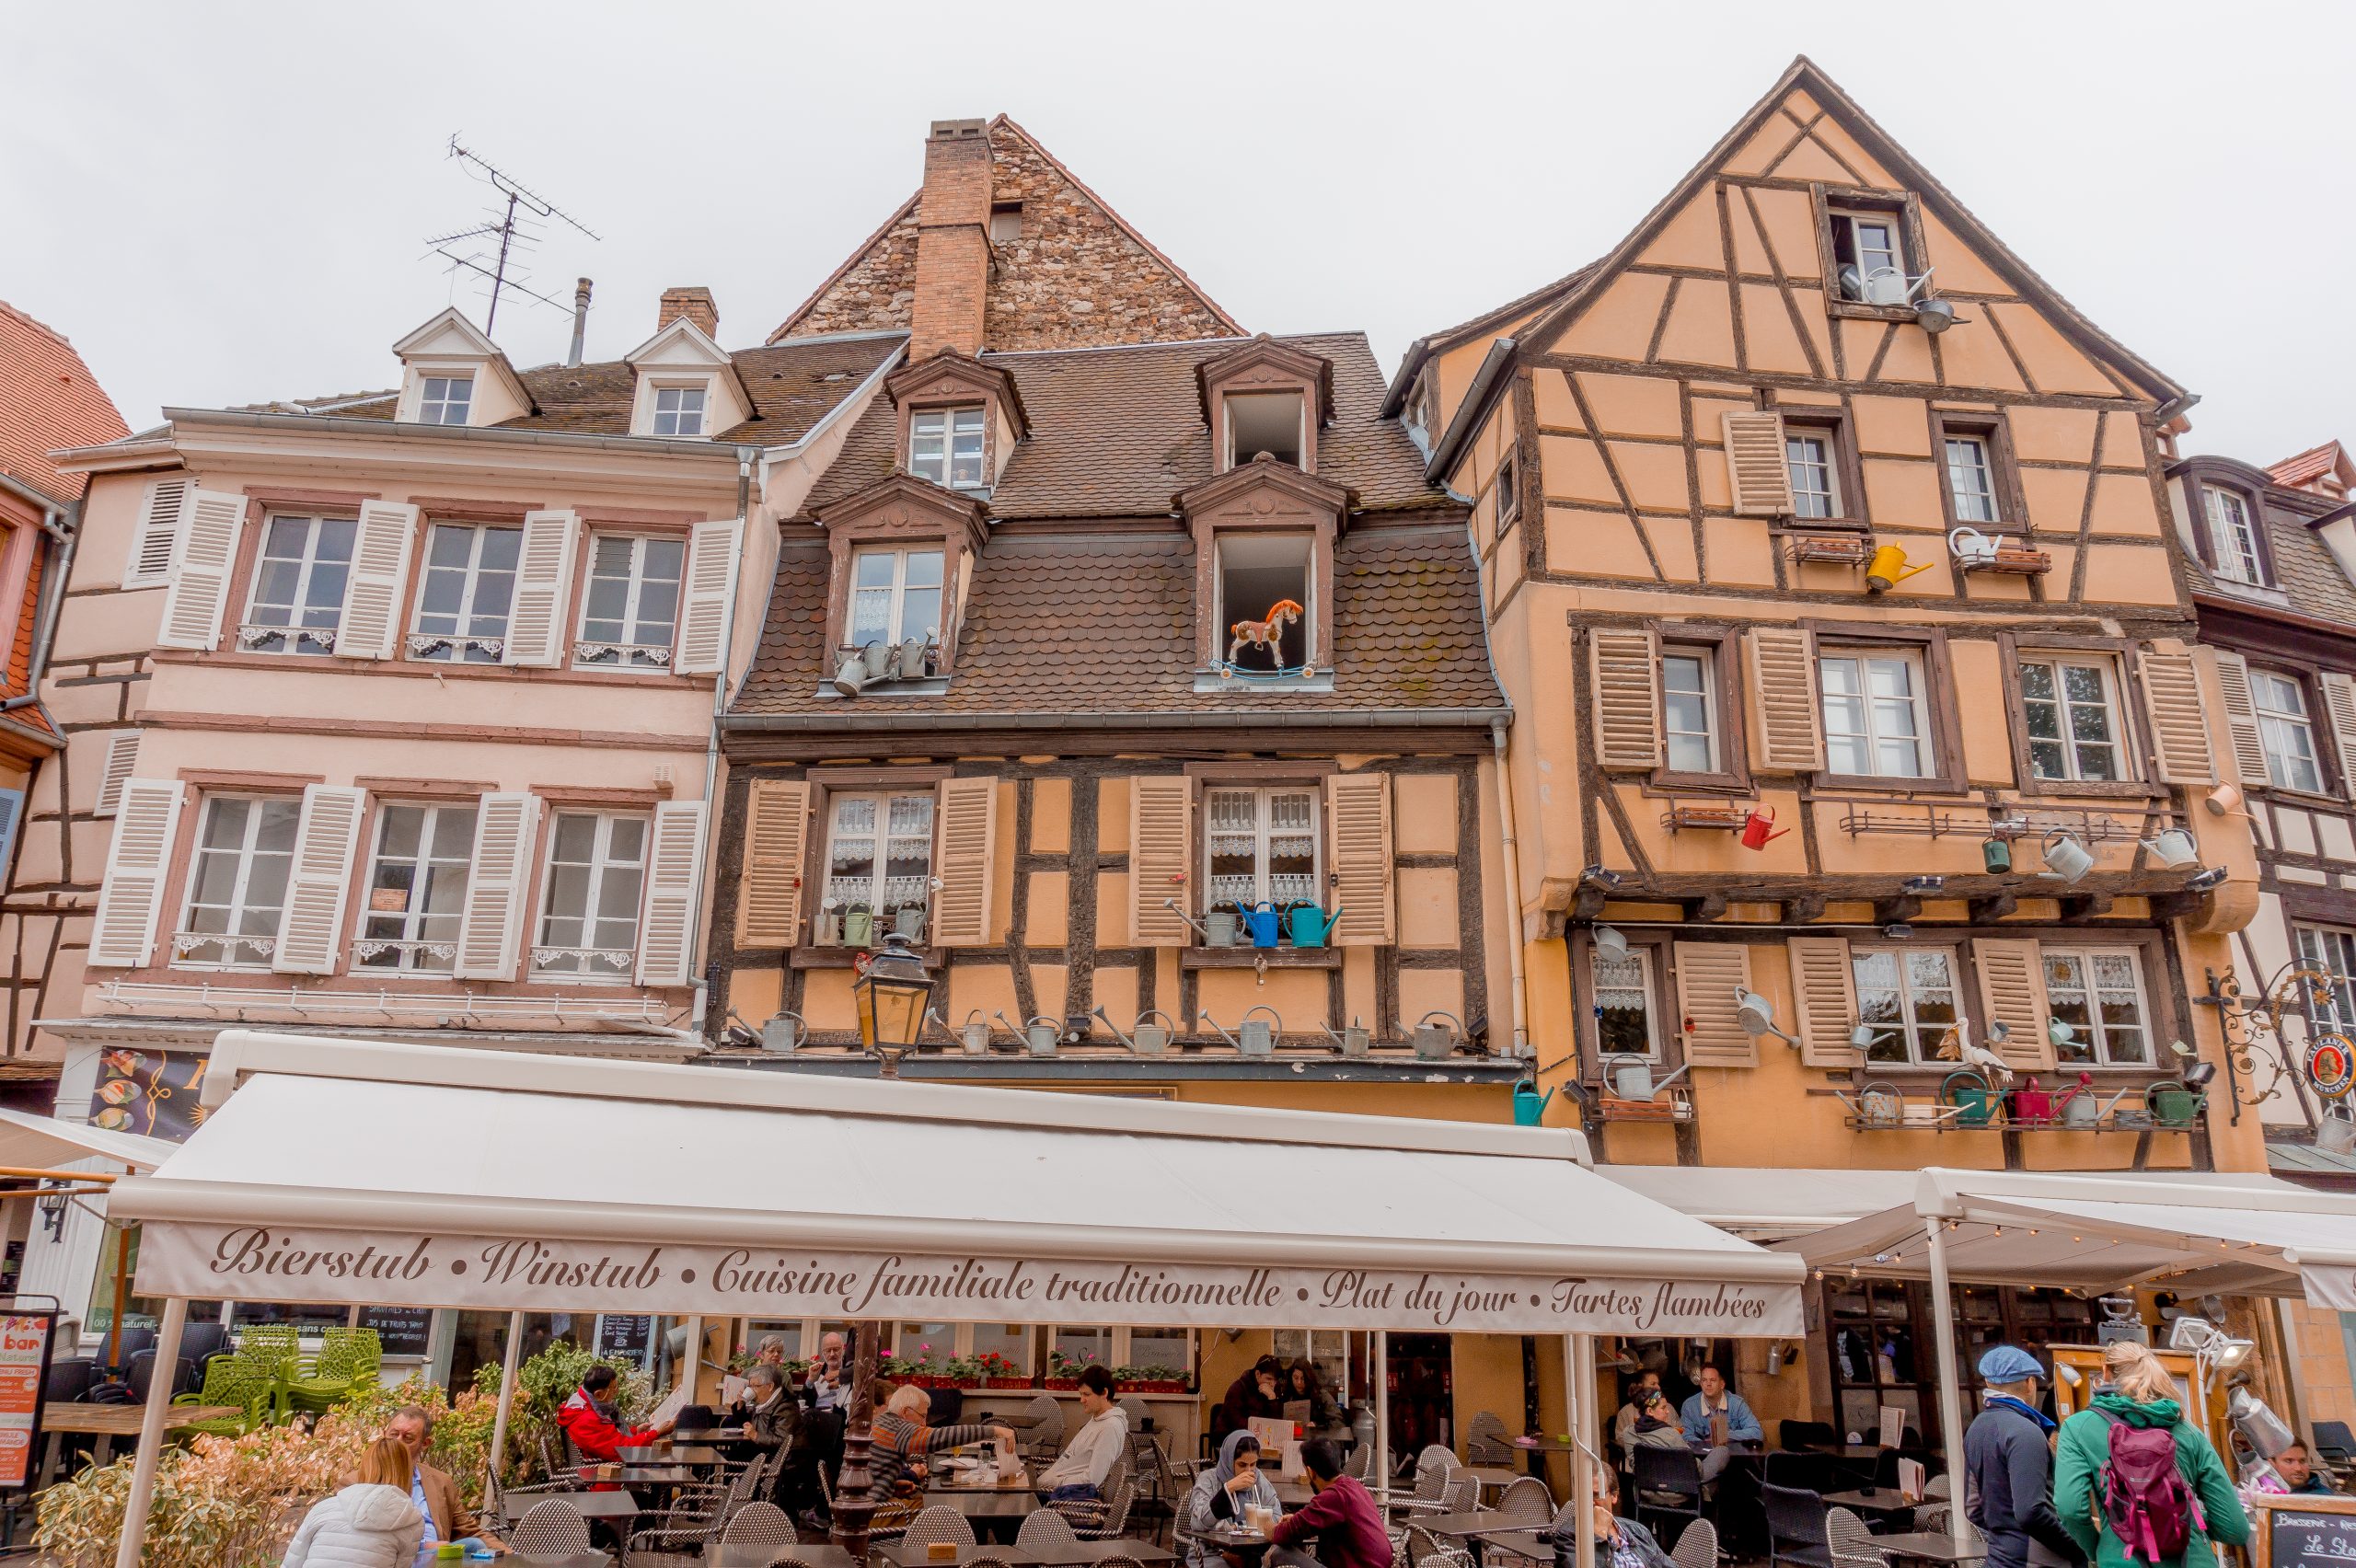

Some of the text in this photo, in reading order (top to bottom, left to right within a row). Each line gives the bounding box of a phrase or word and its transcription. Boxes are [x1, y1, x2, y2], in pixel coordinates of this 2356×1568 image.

[2307, 1037, 2349, 1062] PAULANER
[211, 1228, 1766, 1330] Bierstub Winstub Cuisine familiale traditionnelle Plat du jour Tartes flambées
[4, 1333, 40, 1351] bar
[2304, 1534, 2325, 1553] Le
